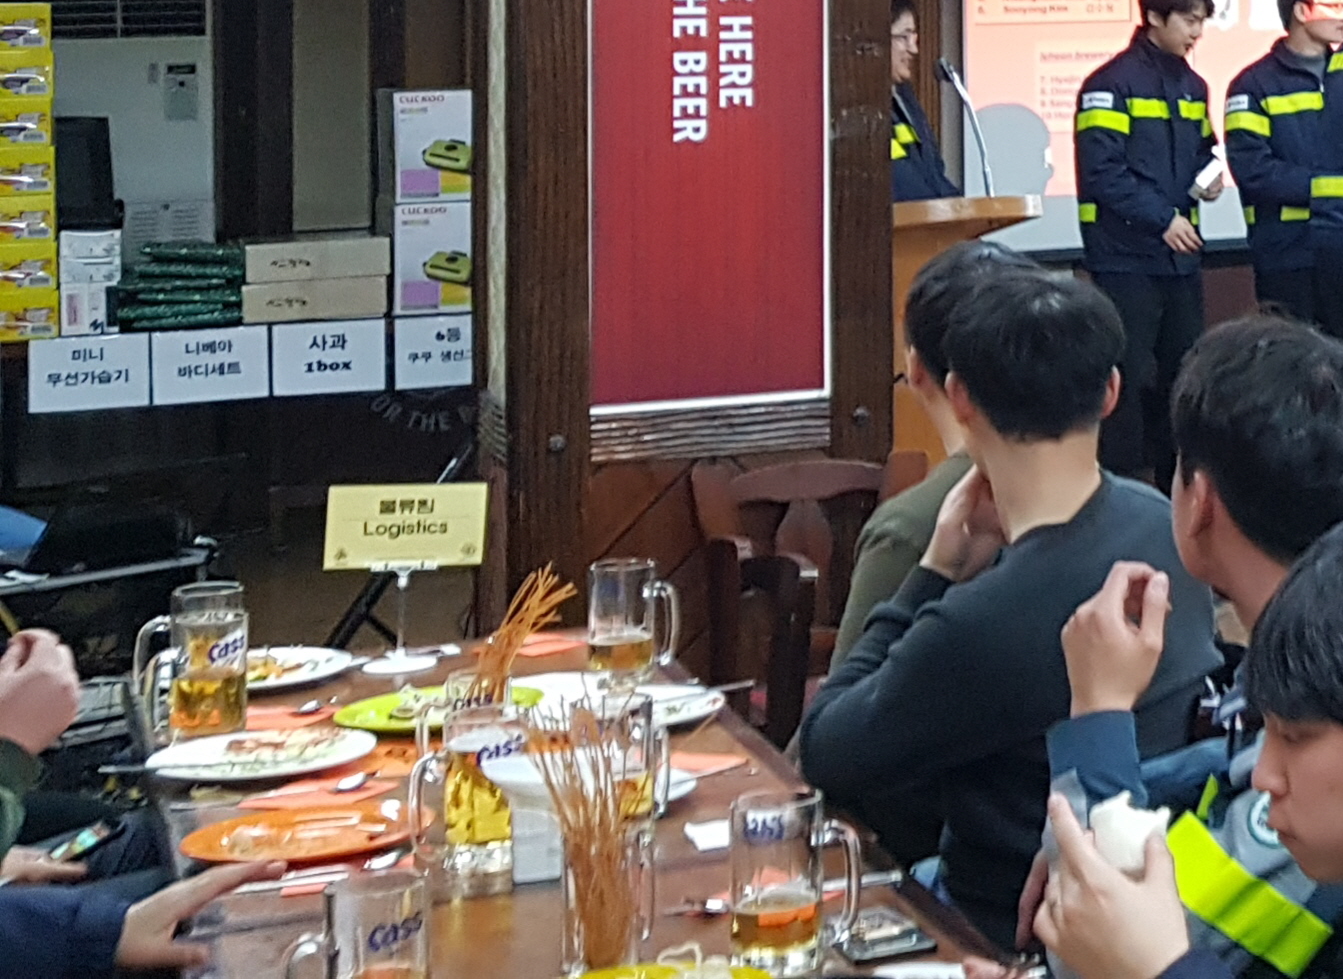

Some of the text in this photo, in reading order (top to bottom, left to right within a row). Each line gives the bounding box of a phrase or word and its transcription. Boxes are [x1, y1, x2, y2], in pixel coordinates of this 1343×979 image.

[718, 15, 753, 108] HERE
[399, 94, 445, 103] CUCKOO
[672, 51, 708, 143] BEER
[401, 207, 447, 215] CUCKOO
[308, 333, 349, 352] 사과
[435, 326, 462, 343] 6등
[71, 346, 104, 362] 미니
[184, 339, 234, 356] 니베아
[408, 351, 433, 364] 쿠쿠
[177, 361, 242, 379] 바디세트
[304, 360, 352, 374] 1box
[46, 368, 130, 388] 무선가습기
[379, 498, 435, 515] 물류팀
[363, 521, 448, 539] Logistics
